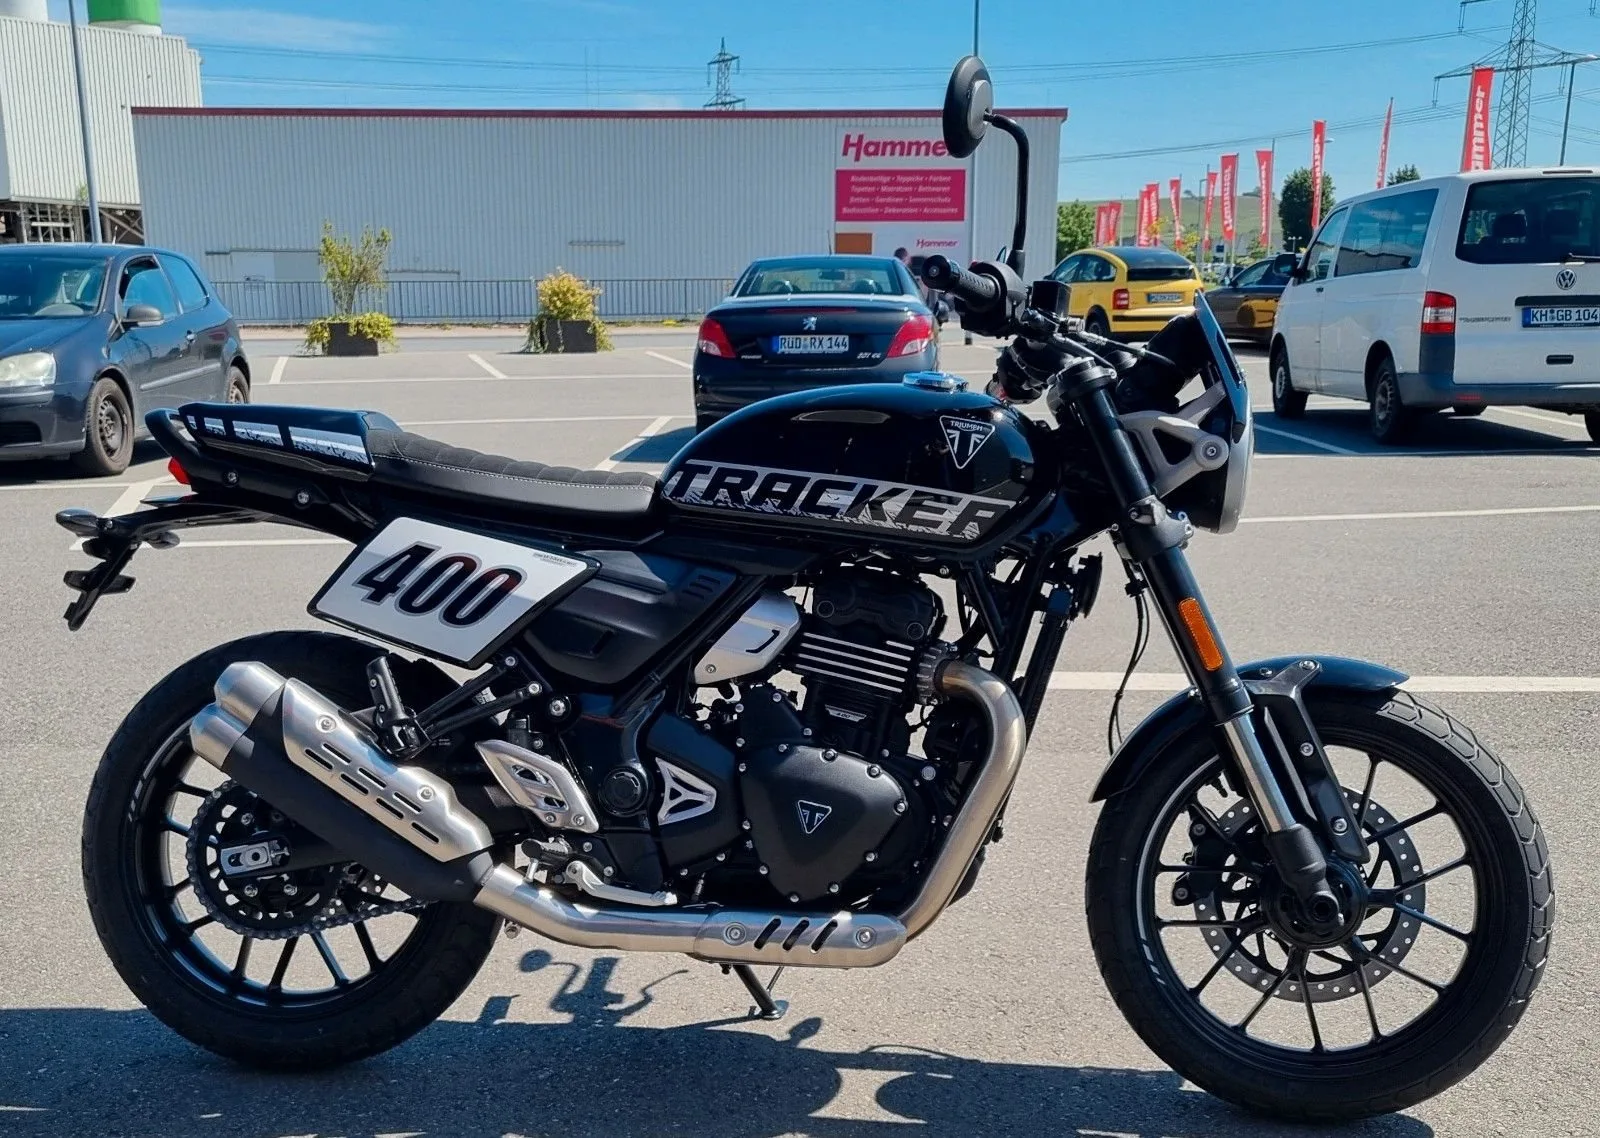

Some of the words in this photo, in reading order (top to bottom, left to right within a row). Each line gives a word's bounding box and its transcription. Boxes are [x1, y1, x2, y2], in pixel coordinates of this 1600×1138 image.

[1471, 85, 1485, 170] ammer
[842, 133, 951, 162] Hamme
[916, 238, 958, 249] Hammer
[1575, 308, 1598, 321] 104
[827, 335, 848, 349] 144
[950, 420, 984, 431] TRIUMPH
[665, 463, 1012, 539] TRACKER
[352, 540, 528, 629] 400
